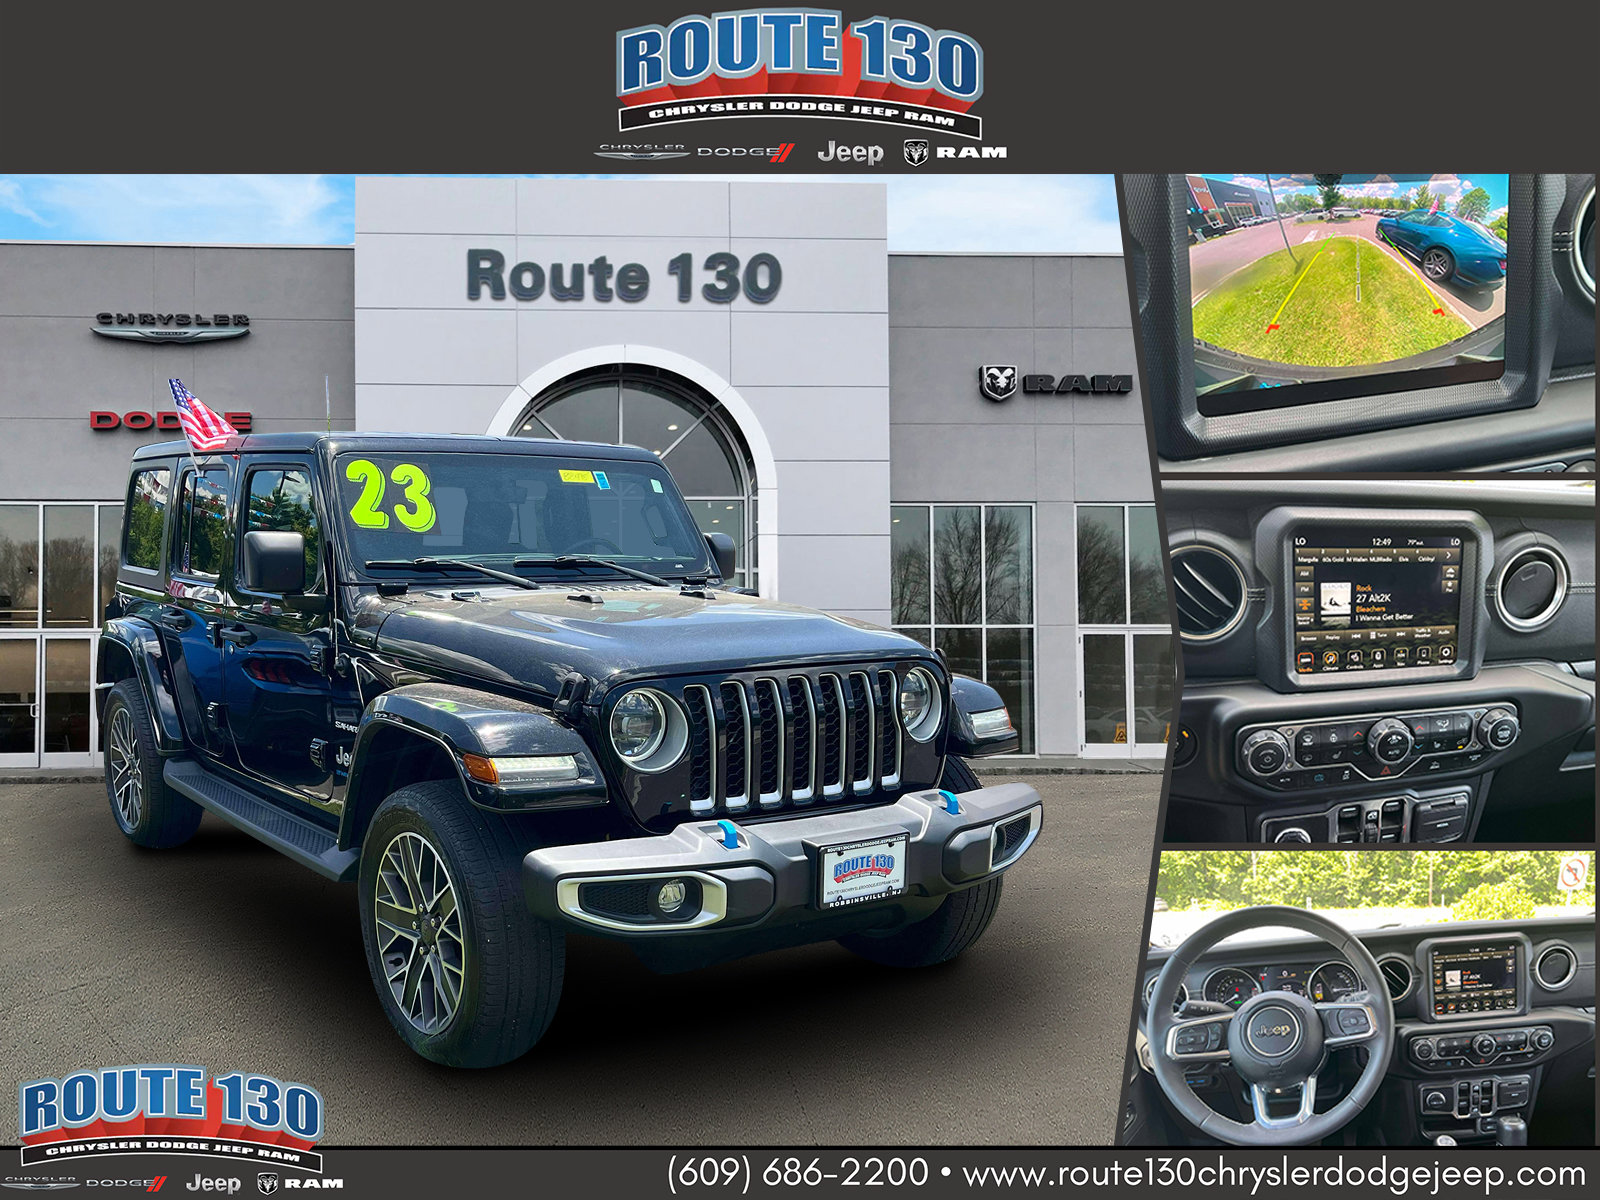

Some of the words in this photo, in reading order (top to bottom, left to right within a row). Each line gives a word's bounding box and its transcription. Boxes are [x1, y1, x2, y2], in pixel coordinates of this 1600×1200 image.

[467, 248, 650, 301] Route
[668, 252, 783, 304] 130
[96, 312, 250, 326] CHRYSLER
[1023, 374, 1133, 395] RAM
[90, 411, 252, 431] DODE
[345, 459, 437, 533] 23
[1371, 538, 1393, 546] 12:49
[1356, 584, 1373, 592] Rock
[1356, 594, 1367, 603] 27
[1369, 593, 1391, 603] Alt2K
[1356, 605, 1386, 613] Bleachers
[1359, 614, 1381, 622] Wanna
[1382, 613, 1395, 621] Get
[1395, 613, 1414, 621] Better
[834, 855, 872, 877] ROUTE
[875, 854, 895, 869] 130
[829, 892, 889, 908] ROBBINSVILLE,
[1255, 1023, 1291, 1042] Jeep
